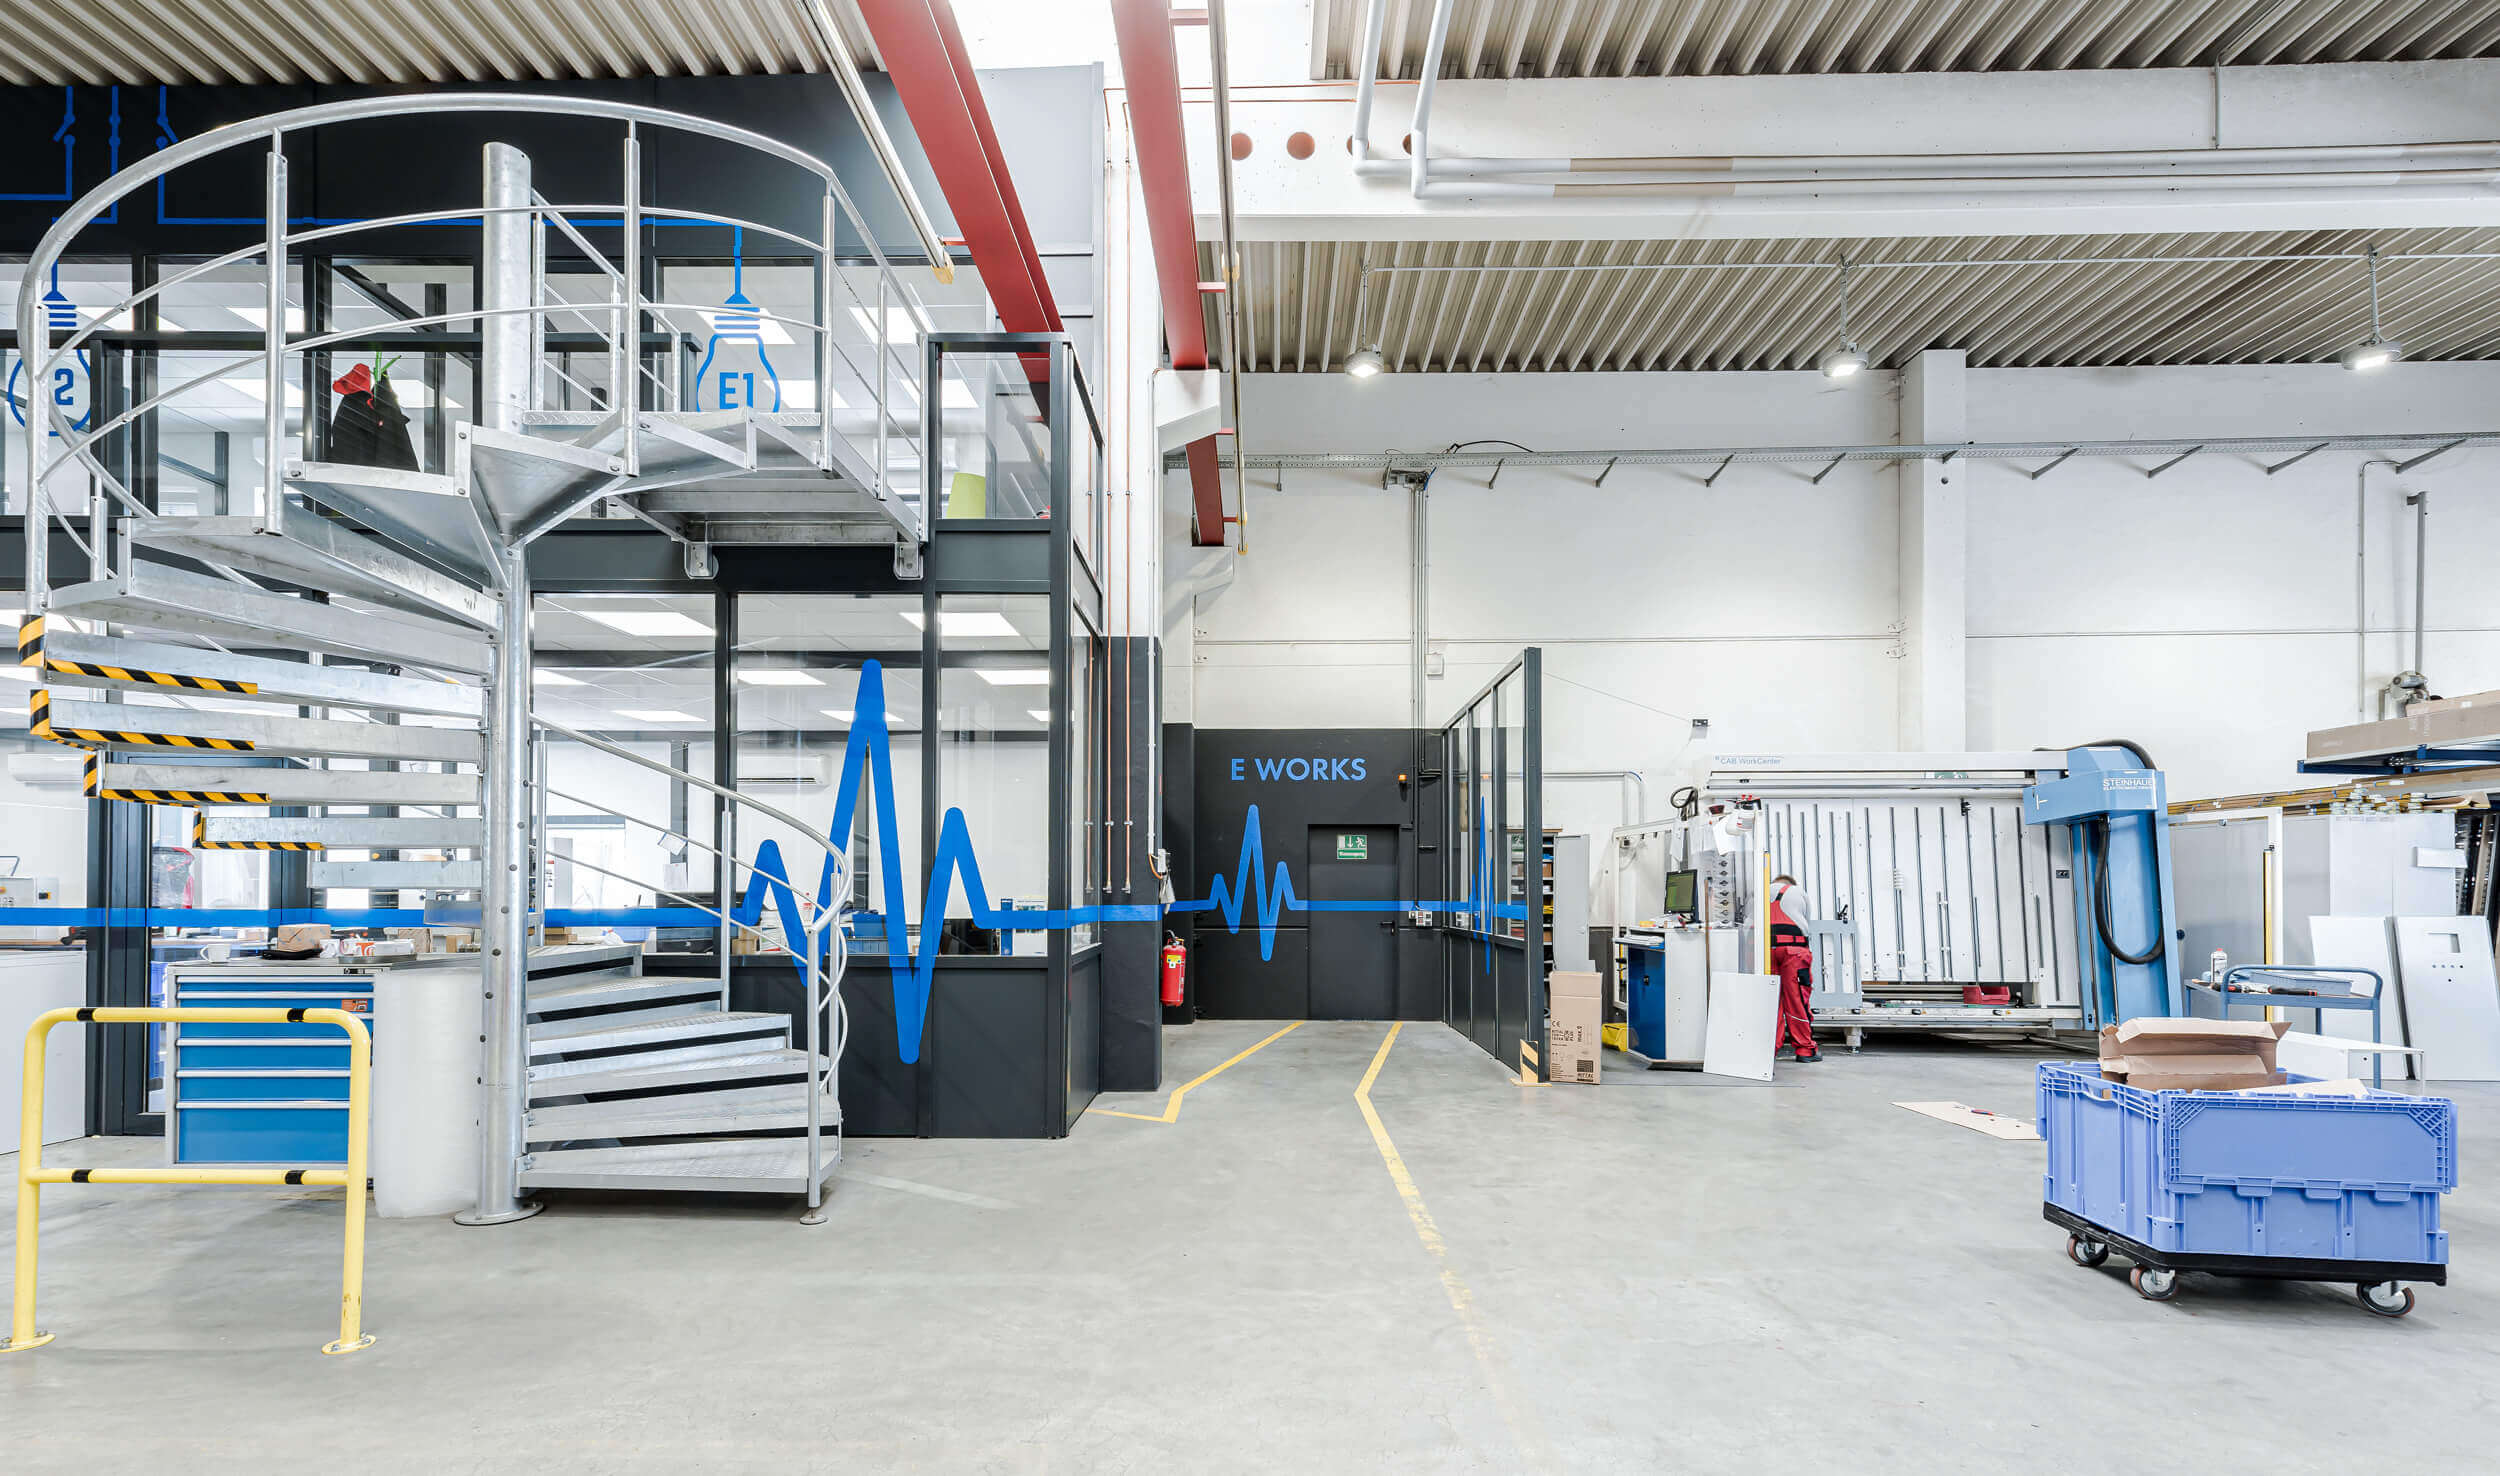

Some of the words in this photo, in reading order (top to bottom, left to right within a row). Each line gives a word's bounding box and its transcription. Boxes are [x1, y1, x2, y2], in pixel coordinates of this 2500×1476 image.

[719, 372, 754, 410] E1
[1231, 758, 1245, 781] E
[1254, 758, 1367, 781] WORKS
